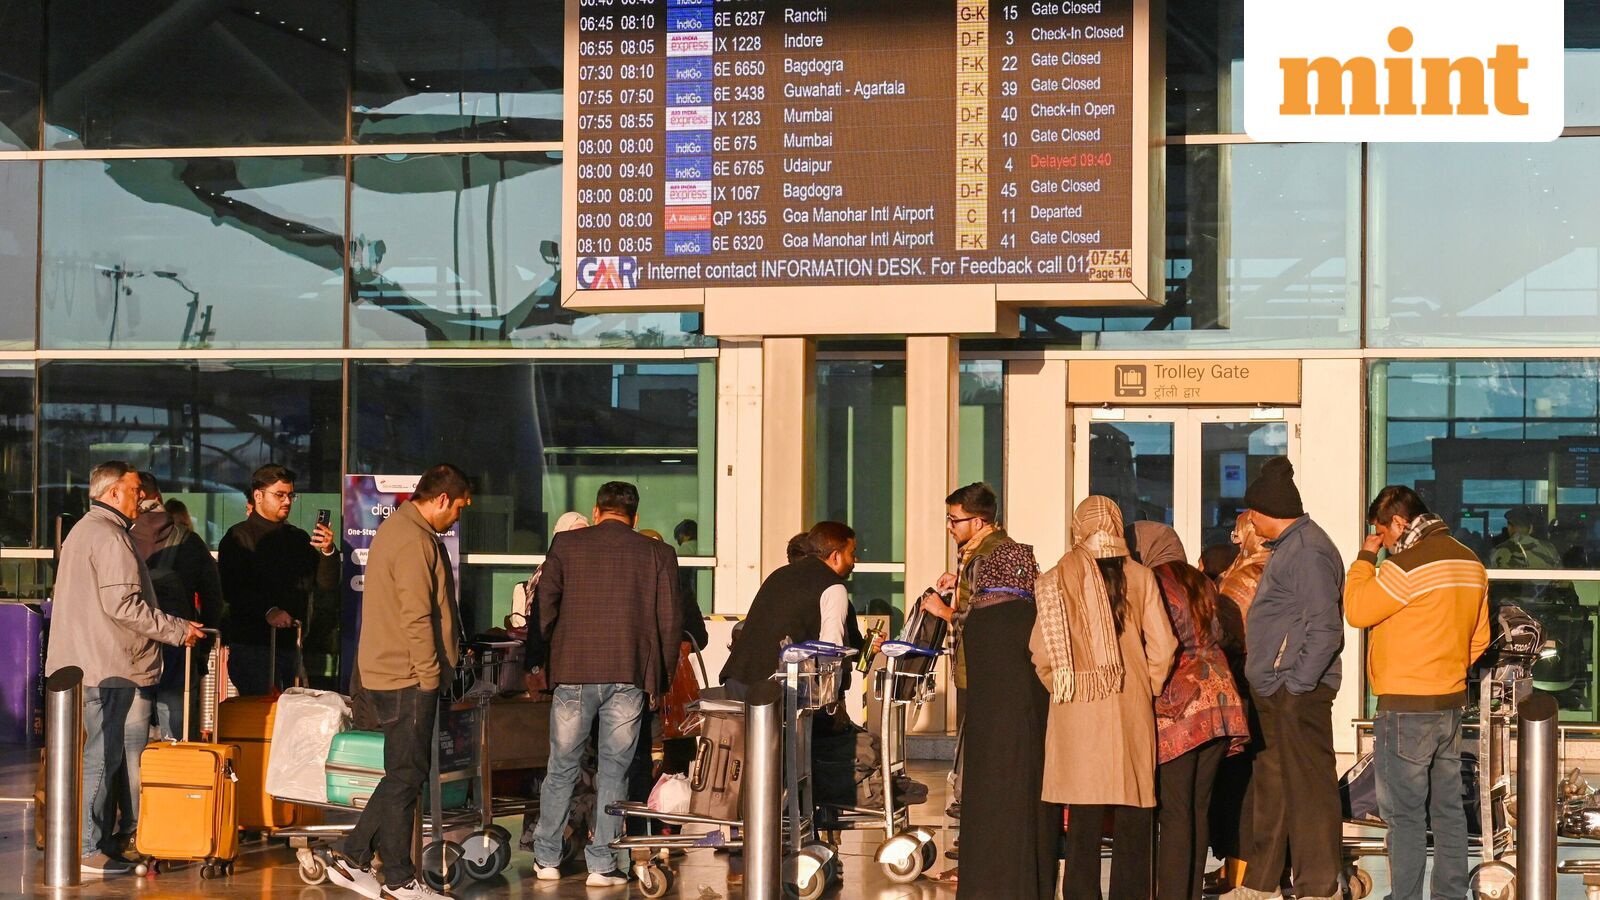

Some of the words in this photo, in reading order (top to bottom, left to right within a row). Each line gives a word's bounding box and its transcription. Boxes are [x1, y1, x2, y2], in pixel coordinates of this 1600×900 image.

[580, 16, 613, 31] 06:45
[621, 15, 654, 29] 08:10
[677, 19, 702, 29] IndiGo
[715, 12, 731, 26] 6E
[735, 11, 765, 26] 6287
[785, 8, 826, 22] Ranchi
[960, 7, 986, 21] G-K
[1004, 6, 1018, 20] 15
[1032, 2, 1058, 15] Gate
[1062, 1, 1100, 14] Closed
[580, 41, 613, 55] 06:55
[621, 40, 654, 54] 08:05
[671, 41, 708, 52] express
[715, 37, 727, 51] IX
[732, 36, 761, 51] 1228
[785, 33, 823, 47] Indore
[962, 32, 984, 46] D-F
[1006, 31, 1013, 45] 3
[1032, 27, 1081, 40] Check-In
[1085, 25, 1123, 38] Closed
[580, 65, 612, 80] 07:30
[621, 64, 654, 79] 08:10
[677, 68, 701, 79] IndiGo
[714, 62, 730, 76] 6E
[735, 61, 765, 75] 6650
[785, 58, 843, 76] Bagdogra
[962, 57, 984, 71] F-K
[1002, 56, 1017, 71] 22
[1032, 53, 1058, 66] Gate
[1062, 51, 1100, 65] Closed
[580, 90, 612, 104] 07:55
[621, 89, 653, 103] 07:50
[676, 93, 701, 103] IndiGo
[714, 87, 730, 101] 6E
[735, 86, 764, 100] 3438
[784, 83, 841, 97] Guwahati
[854, 80, 905, 99] Agartala
[961, 82, 984, 96] F-K
[1002, 82, 1017, 95] 39
[1031, 78, 1058, 91] Gate
[1062, 77, 1100, 90] Closed
[579, 115, 612, 129] 07:55
[620, 114, 653, 128] 08:55
[670, 115, 708, 126] express
[715, 112, 726, 126] IX
[732, 111, 760, 125] 1283
[784, 108, 832, 122] Mumbai
[961, 107, 984, 121] D-F
[1001, 107, 1017, 121] 40
[1031, 103, 1080, 116] Check-In
[1085, 102, 1115, 118] Open
[579, 139, 612, 154] 08:00
[620, 138, 653, 153] 08:00
[676, 143, 701, 153] IndiGo
[714, 137, 730, 151] 6E
[734, 136, 756, 150] 675
[784, 132, 832, 147] Mumbai
[961, 133, 984, 147] F-K
[1003, 132, 1017, 146] 10
[1031, 129, 1057, 142] Gate
[1062, 128, 1100, 141] Closed
[579, 164, 611, 178] 08:00
[620, 163, 653, 177] 09:40
[676, 167, 700, 178] IndiGo
[713, 161, 729, 175] 6E
[734, 160, 764, 175] 6765
[784, 158, 832, 175] Udaipur
[961, 158, 984, 172] F-K
[1005, 157, 1013, 172] 4
[1030, 154, 1077, 170] Delayed
[1080, 153, 1112, 167] 09:40
[579, 189, 611, 203] 08:00
[620, 188, 652, 202] 08:00
[670, 190, 707, 200] express
[714, 187, 726, 200] IX
[731, 186, 760, 200] 1067
[784, 183, 842, 201] Bagdogra
[961, 184, 984, 198] D-F
[1001, 183, 1017, 197] 45
[1031, 180, 1057, 193] Gate
[1061, 179, 1100, 192] Closed
[578, 214, 611, 228] 08:00
[619, 213, 652, 227] 08:00
[713, 211, 731, 226] QP
[738, 211, 766, 225] 1355
[783, 208, 808, 222] Goa
[813, 207, 867, 222] Manohar
[871, 206, 889, 221] Intl
[893, 206, 934, 224] Airport
[966, 209, 977, 223] C
[1002, 208, 1015, 223] 11
[1031, 205, 1081, 221] Departed
[578, 238, 611, 252] 08:10
[619, 237, 652, 252] 08:05
[675, 242, 700, 253] IndiGo
[713, 236, 729, 250] 6E
[733, 236, 763, 250] 6320
[783, 233, 808, 247] Goa
[813, 232, 867, 247] Manohar
[871, 232, 888, 246] Intl
[893, 231, 933, 249] Airport
[960, 234, 983, 248] F-K
[1001, 234, 1014, 248] 41
[1031, 231, 1057, 244] Gate
[1061, 230, 1100, 243] Closed
[648, 262, 701, 279] Internet
[705, 262, 756, 278] contact
[762, 259, 872, 277] INFORMATION
[878, 258, 925, 276] DESK.
[932, 257, 955, 274] For
[961, 256, 1032, 274] Feedback
[1038, 256, 1062, 273] call
[1091, 251, 1128, 265] 07:54
[1089, 268, 1114, 281] Page
[1118, 268, 1132, 279] 1/6
[1154, 364, 1205, 382] Trolley
[1211, 364, 1250, 379] Gate
[1153, 385, 1178, 399] ट्रॉली
[1183, 387, 1200, 399] द्वार
[347, 528, 377, 537] One-Step
